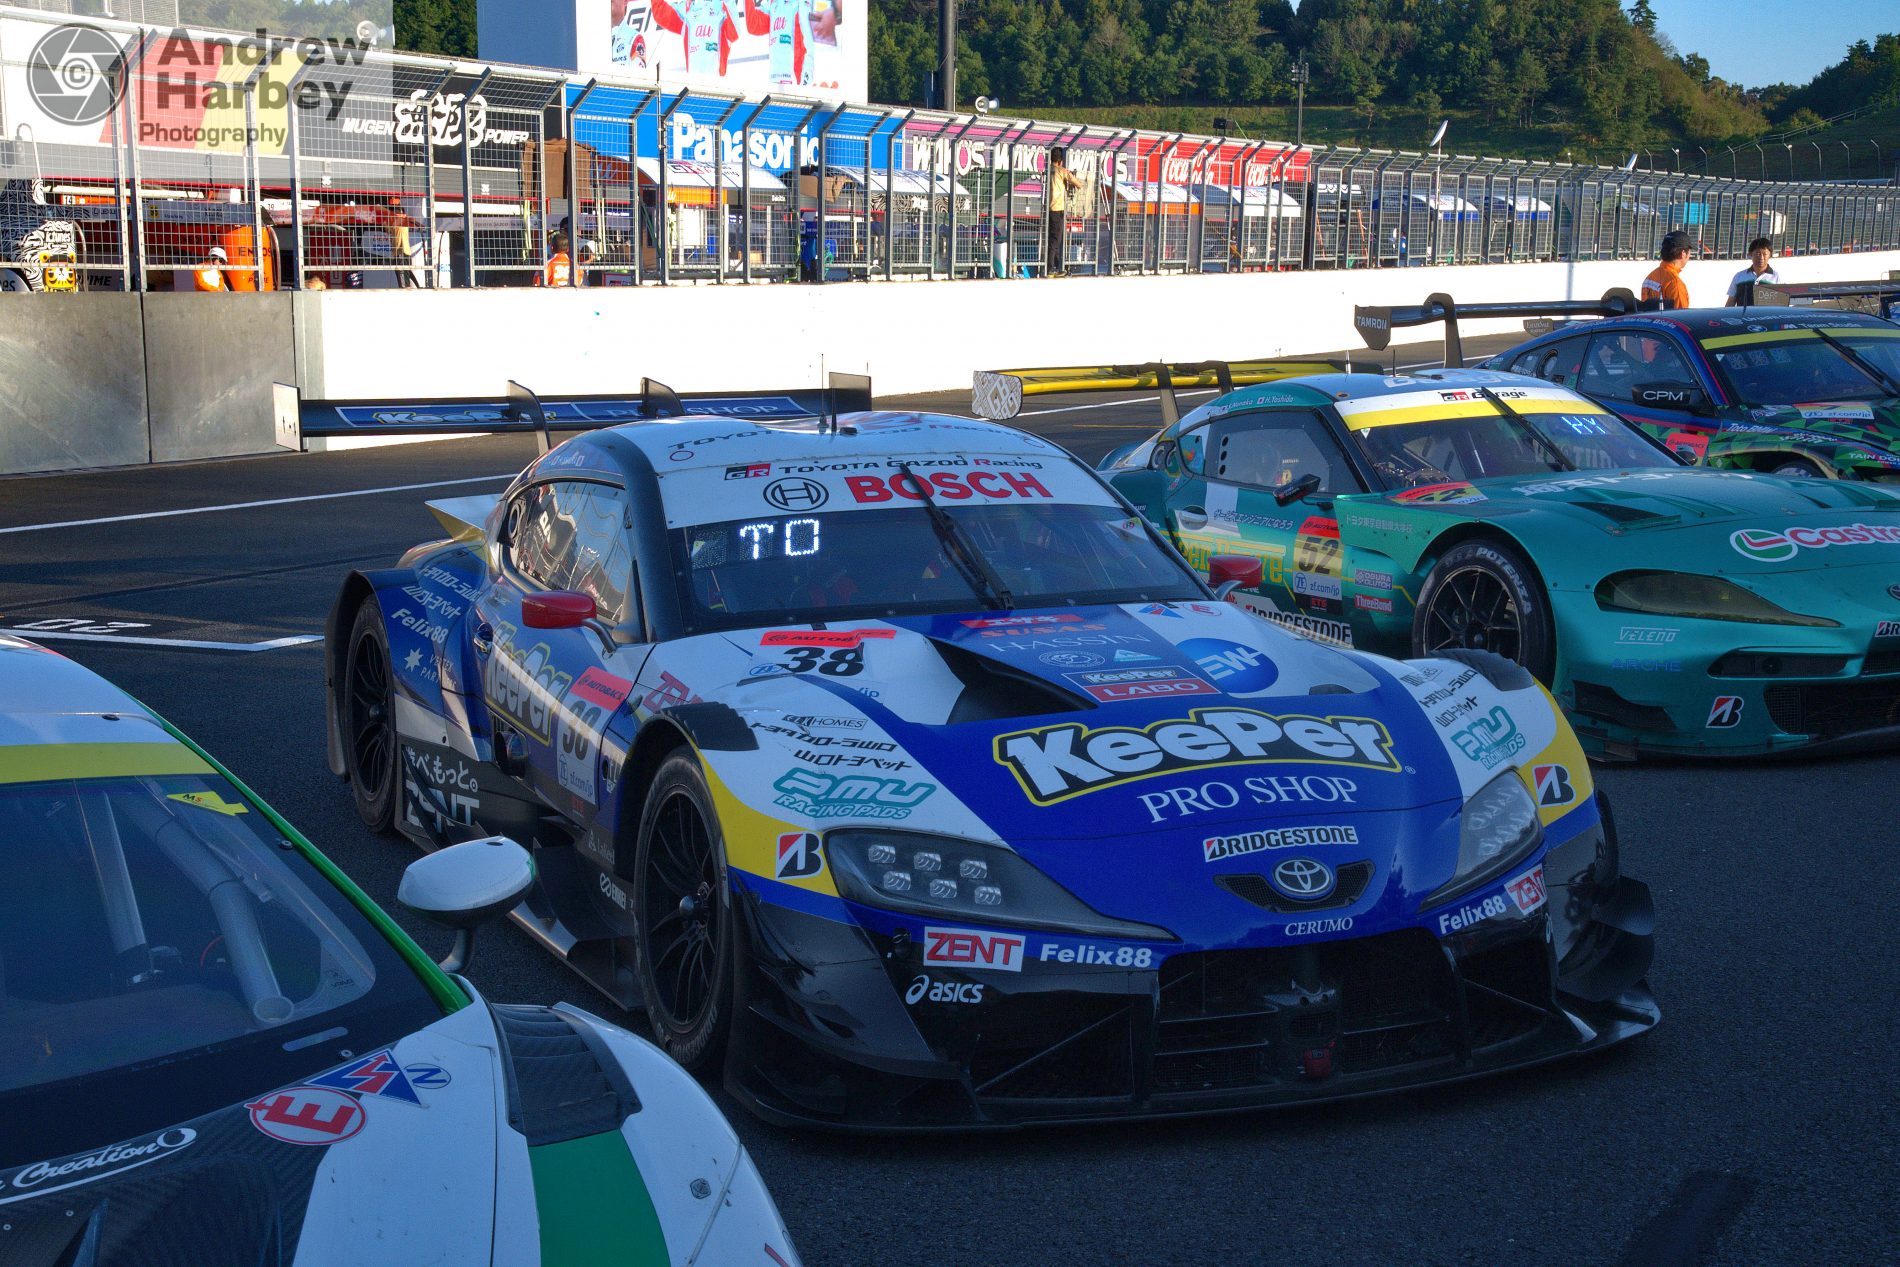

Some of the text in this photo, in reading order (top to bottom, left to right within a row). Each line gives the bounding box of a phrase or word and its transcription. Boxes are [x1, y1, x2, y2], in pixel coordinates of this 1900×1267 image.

[342, 117, 395, 137] MUGEN
[484, 128, 530, 146] POWER
[672, 112, 821, 169] Panasonic
[238, 246, 272, 258] ENOS
[1356, 315, 1388, 331] TAMRON
[1472, 389, 1528, 400] Grage
[1642, 391, 1684, 402] CPM
[667, 430, 773, 449] TOYOT
[728, 466, 769, 480] GR
[778, 461, 880, 475] TOYOTA
[973, 458, 1044, 471] Racing
[844, 471, 1054, 503] BOSCH
[1298, 536, 1339, 575] 52
[1309, 580, 1340, 596] zf.com/jp
[1363, 579, 1392, 590] CLUTCH
[1476, 545, 1534, 615] POTENZA
[1355, 594, 1393, 612] ThreeBond
[391, 607, 449, 645] Felix88
[1618, 630, 1677, 642] VELENO
[776, 646, 865, 677] 38
[1083, 669, 1177, 683] KeePer
[1103, 682, 1200, 697] LABO
[811, 718, 865, 729] HOMES
[793, 749, 913, 772] 山口トヨペット
[998, 708, 1395, 802] KeePer
[773, 767, 937, 808] PMU
[774, 793, 912, 820] RACING PADS
[1136, 775, 1358, 825] PRO SHOP
[1205, 826, 1358, 862] BRIDGESTONE
[1507, 868, 1548, 911] ZENT
[1284, 916, 1353, 937] CERUMO
[1438, 894, 1507, 936] Felix88
[926, 931, 1022, 966] ZENT
[1040, 943, 1152, 968] Felix88
[928, 981, 984, 1004] asics
